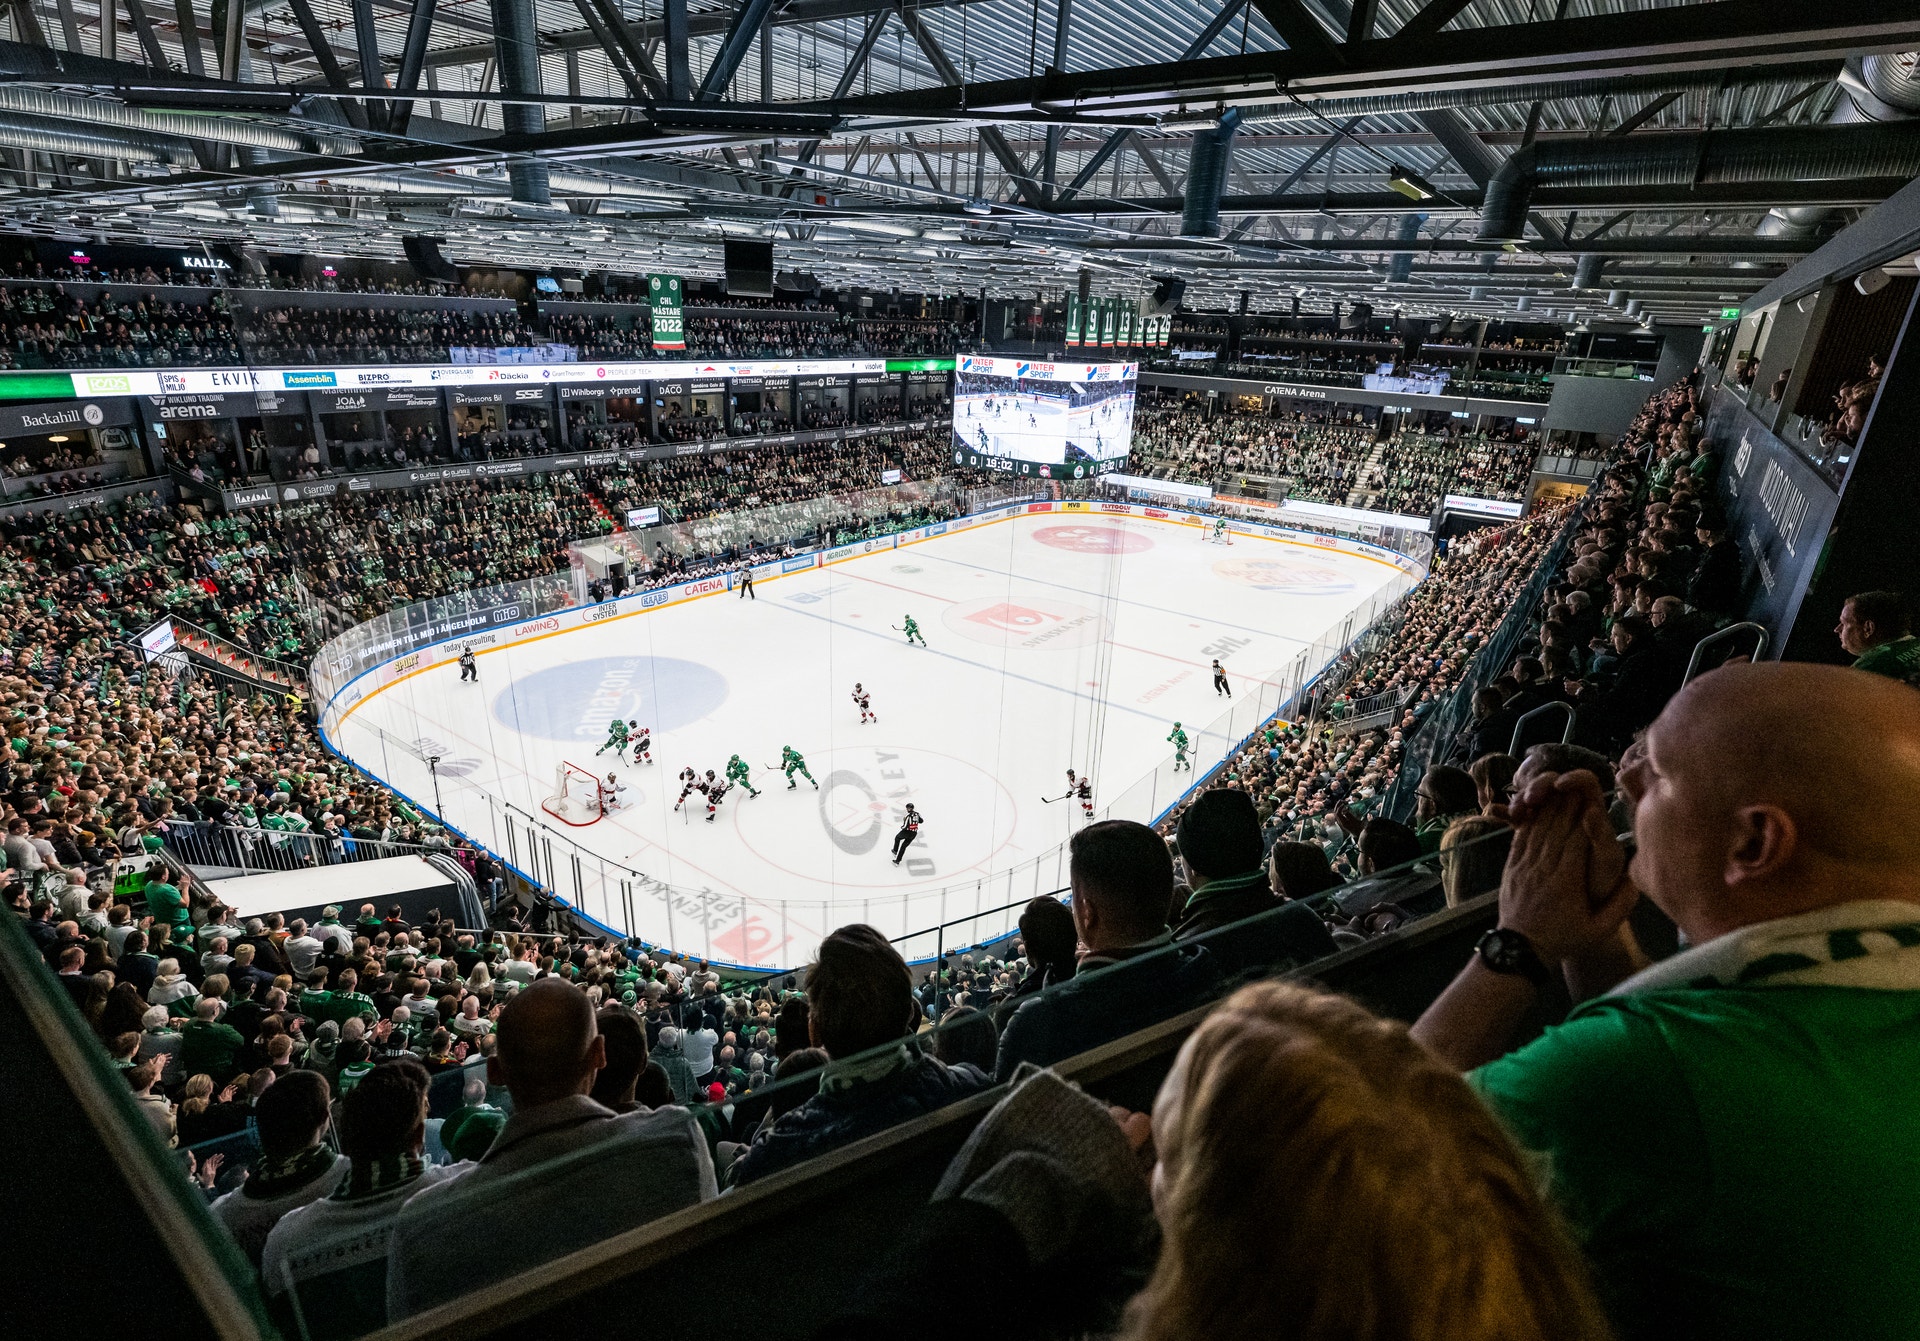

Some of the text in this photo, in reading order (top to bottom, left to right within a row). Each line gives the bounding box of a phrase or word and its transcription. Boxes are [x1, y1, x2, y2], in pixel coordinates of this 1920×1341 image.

[660, 296, 672, 305] CHL
[652, 305, 680, 316] MÄSTARE
[1072, 308, 1077, 330] 1
[1090, 310, 1097, 332] 9
[1104, 312, 1113, 333] 11
[1120, 312, 1130, 332] 13
[1160, 314, 1172, 333] 26
[654, 318, 682, 333] 2022
[972, 358, 994, 366] INTER
[1030, 363, 1054, 372] INTER
[972, 365, 993, 374] SPORT
[1030, 370, 1054, 379] SPORT
[164, 375, 180, 384] SPIS
[212, 372, 260, 386] EKVIK
[288, 374, 332, 384] Assemblin
[826, 377, 836, 386] EY
[515, 389, 544, 400] SSE
[570, 388, 604, 397] Wihlborgs
[616, 386, 641, 396] prenad
[660, 386, 682, 394] DACO
[1264, 385, 1326, 399] CATENA Arena
[167, 394, 224, 404] WIKLUND TRADING
[336, 397, 357, 406] JOA
[160, 404, 220, 418] arema.
[22, 410, 80, 427] Backahill
[970, 456, 976, 465] 0
[986, 457, 1012, 470] 19:02
[1118, 460, 1124, 468] 0
[1022, 464, 1030, 474] 0
[1090, 466, 1094, 475] 0
[1098, 460, 1114, 473] 19:02
[1450, 500, 1478, 508] INTERSPORT
[826, 548, 852, 560] AGRIZON
[684, 579, 723, 596] CATENA
[598, 604, 617, 612] INTER
[592, 610, 618, 621] SYSTEM
[1021, 614, 1098, 649] SVENSKA SPEL
[358, 639, 402, 659] VÄLKOMMEN
[403, 632, 419, 644] TILL
[420, 628, 435, 640] MIO
[440, 616, 487, 632] ÄNGELHOLM
[444, 634, 496, 654] Today Consulting
[1200, 635, 1252, 660] SHL
[394, 654, 419, 672] SPORT
[637, 874, 743, 930] SVENSKA SPEL
